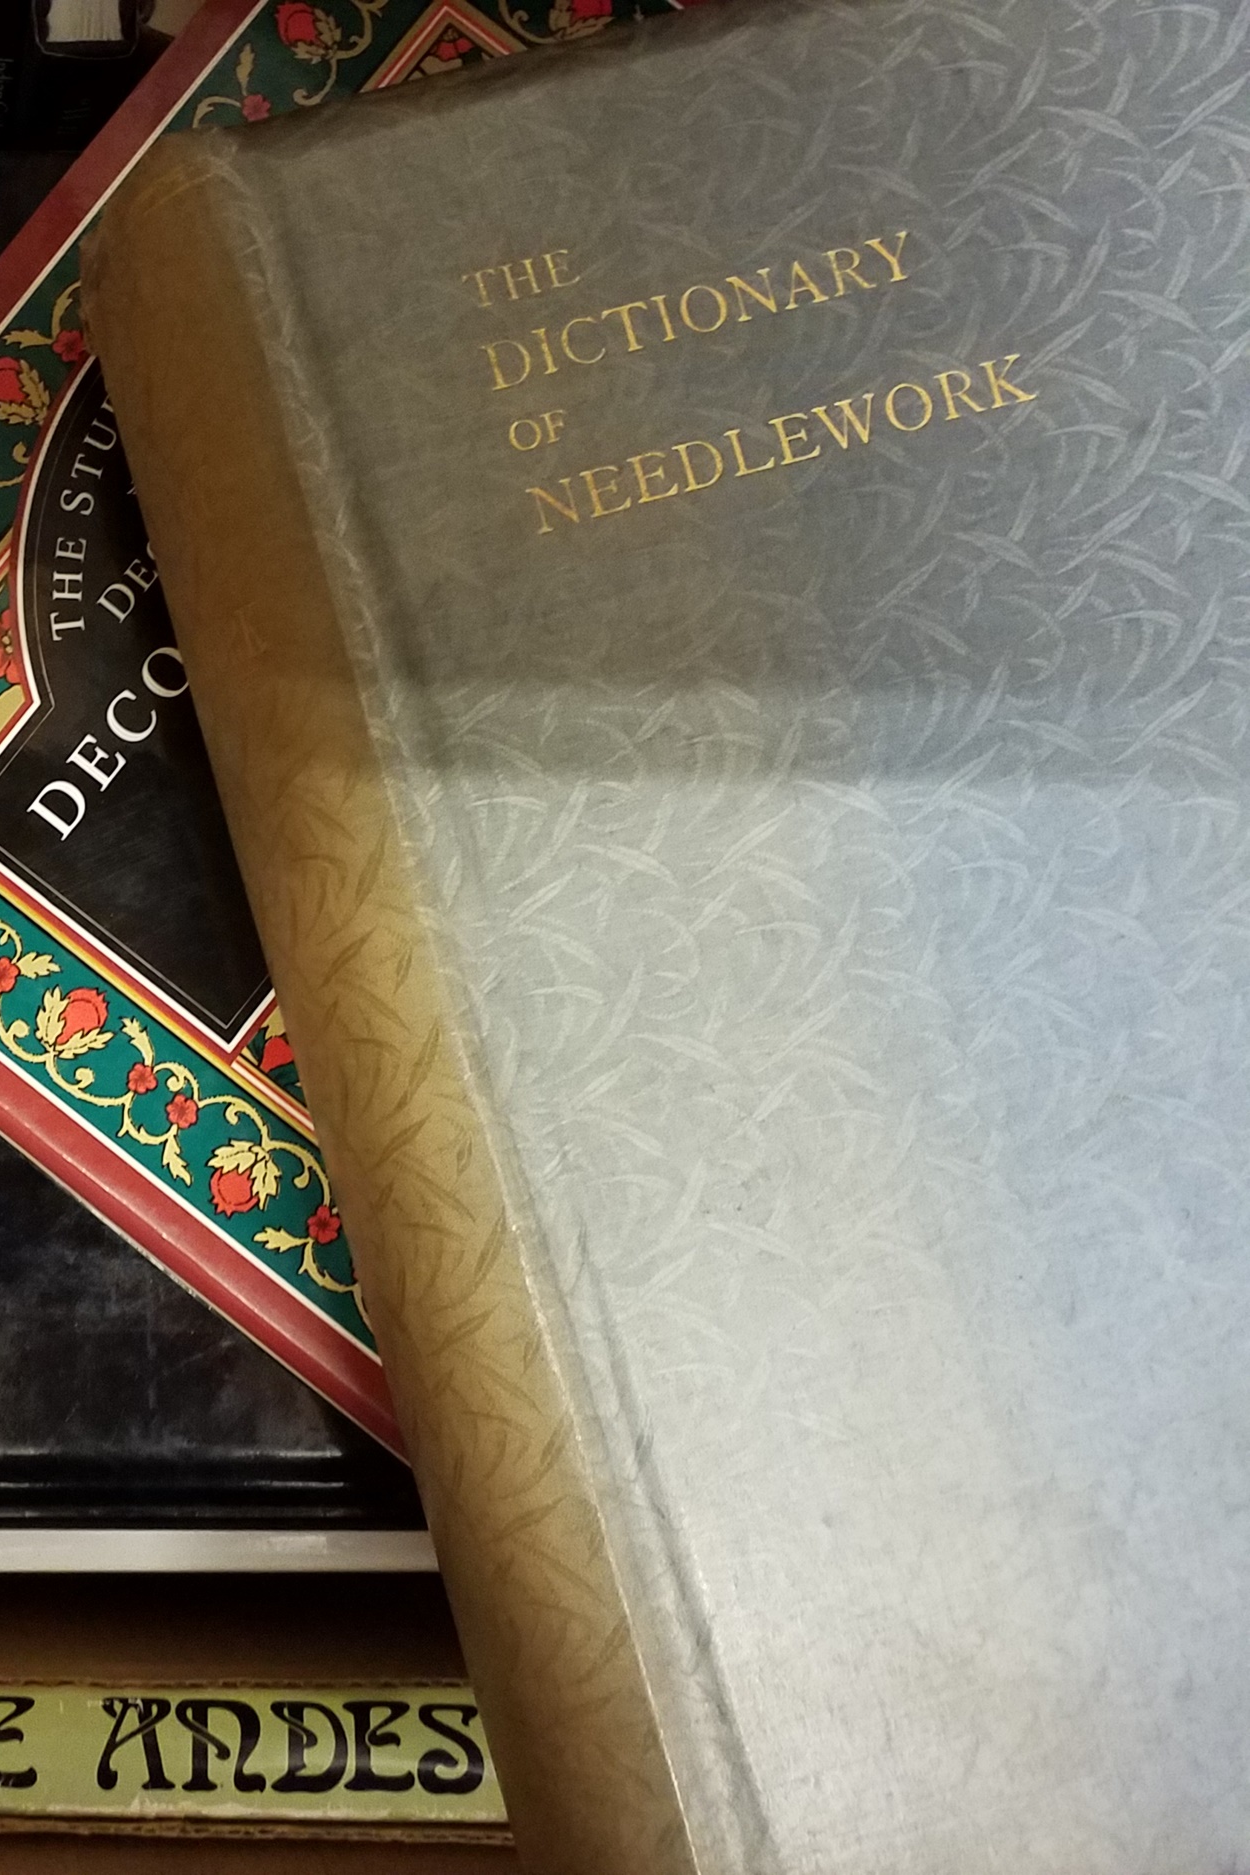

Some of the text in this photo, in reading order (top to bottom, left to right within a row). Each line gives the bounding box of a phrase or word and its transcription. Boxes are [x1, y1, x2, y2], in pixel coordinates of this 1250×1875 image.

[461, 249, 581, 308] THE
[480, 231, 913, 391] DICTIONARY
[508, 410, 567, 451] OF
[525, 354, 1036, 534] NEEDLEWORK
[50, 394, 118, 642] THE STU
[96, 542, 159, 624] DE
[26, 646, 190, 842] DECO
[95, 1696, 485, 1795] ANDES
